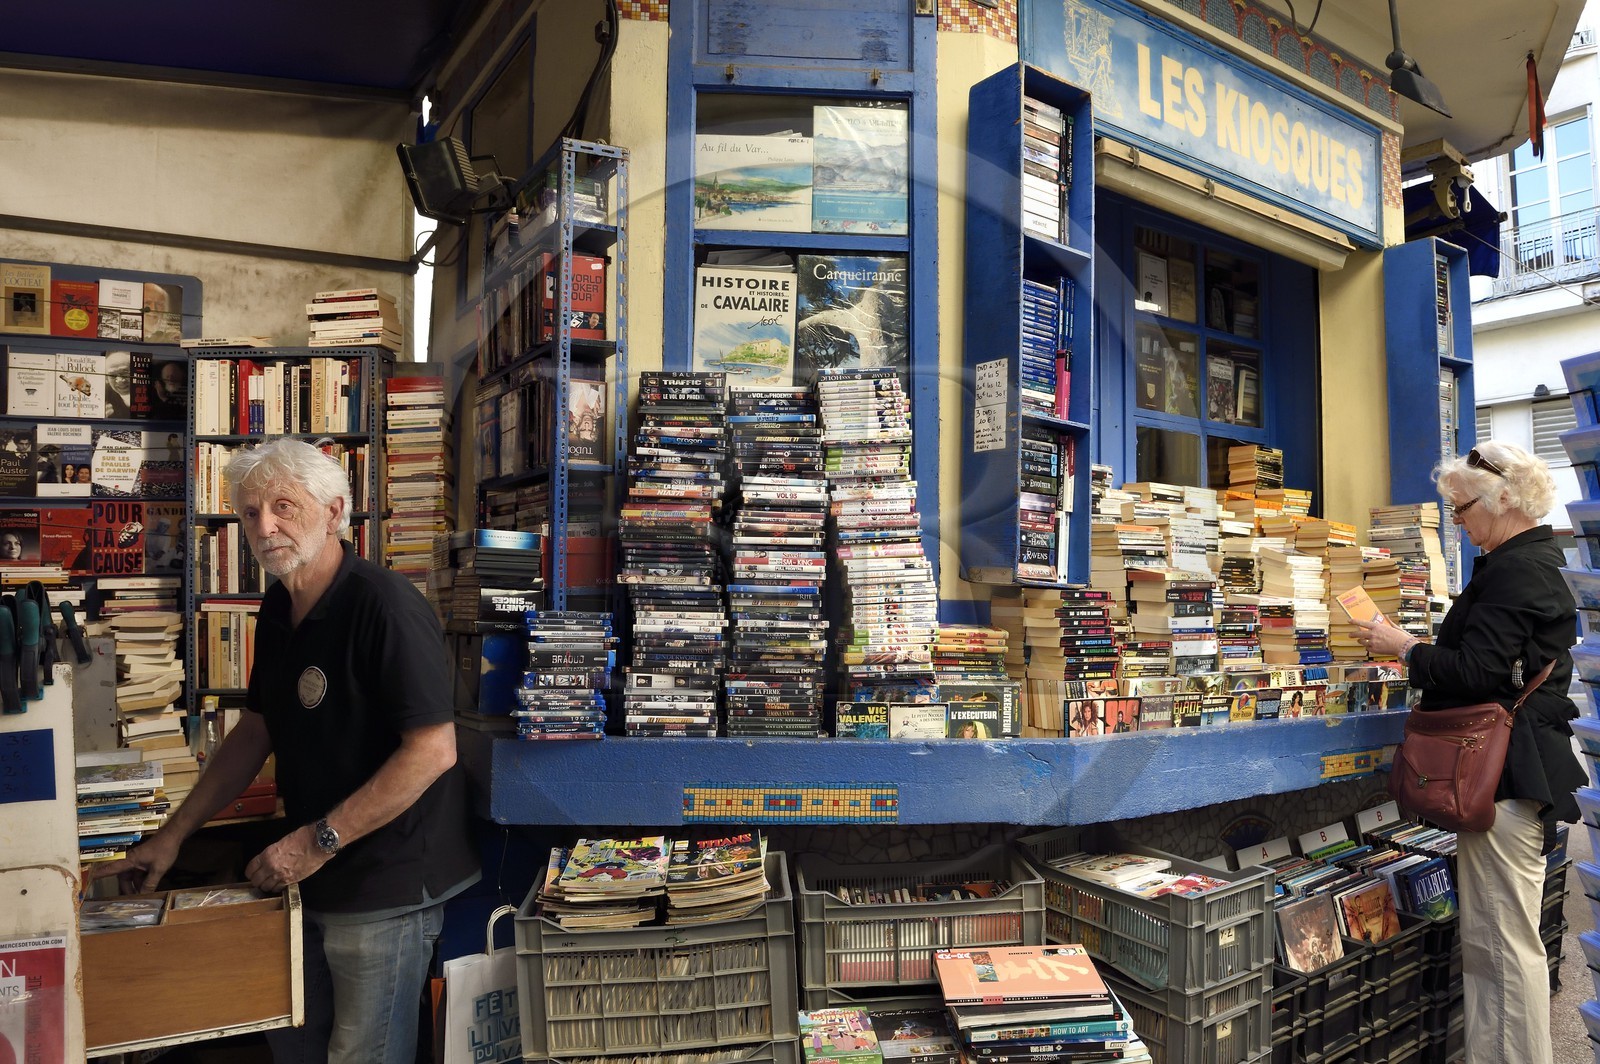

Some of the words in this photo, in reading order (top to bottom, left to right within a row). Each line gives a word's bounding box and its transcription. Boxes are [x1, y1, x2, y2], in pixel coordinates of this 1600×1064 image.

[1137, 43, 1207, 138] LES
[1216, 82, 1364, 209] KIOSQUES
[700, 142, 715, 154] Au
[717, 142, 728, 154] fil
[729, 143, 742, 154] du
[813, 263, 902, 288] Carqueiranne
[572, 283, 599, 293] OKER
[702, 276, 790, 291] HISTOIRE
[571, 292, 592, 302] OUR
[713, 296, 789, 313] CAVALAIRE
[67, 363, 96, 372] Pollock
[976, 410, 980, 418] 3
[568, 446, 593, 454] TUDO
[1, 459, 21, 467] Paul
[93, 502, 143, 524] POUR
[93, 527, 115, 547] LA
[1026, 551, 1048, 560] RAVENS
[93, 552, 143, 574] CAUSE
[868, 706, 886, 714] VIC
[1003, 687, 1012, 733] L'EXECUTEUR
[1173, 701, 1202, 714] BLADE
[839, 714, 886, 723] VALENCE
[951, 711, 997, 720] L'EXECUTEUR
[1376, 811, 1383, 821] B
[697, 834, 752, 849] TITANS
[1320, 831, 1328, 842] B
[1261, 847, 1269, 859] A
[1415, 868, 1450, 904] AQUABLUE
[476, 990, 516, 1017] FÊT
[471, 1018, 520, 1047] LIV
[477, 1047, 492, 1060] DU
[502, 1046, 522, 1058] VA
